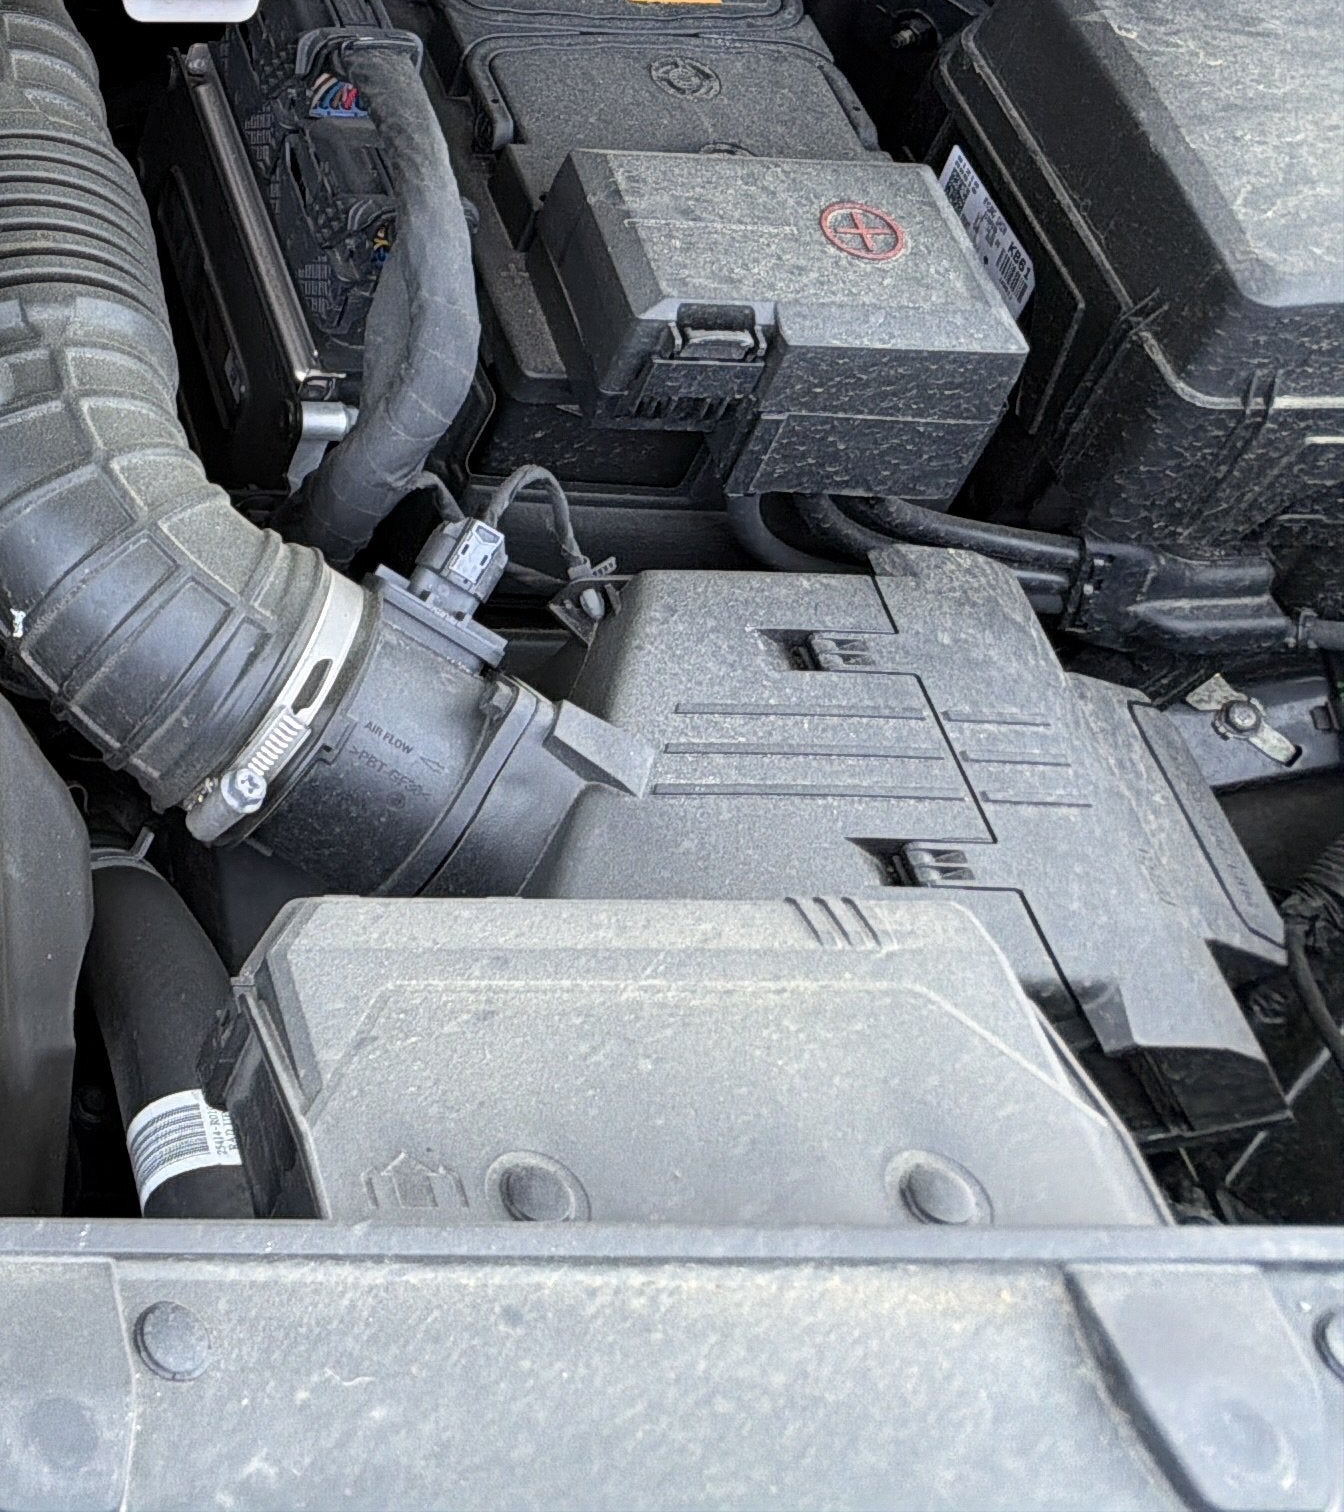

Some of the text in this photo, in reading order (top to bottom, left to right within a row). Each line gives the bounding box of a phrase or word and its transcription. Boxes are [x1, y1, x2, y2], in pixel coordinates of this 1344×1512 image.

[1006, 241, 1031, 281] KB61
[364, 720, 414, 754] AIR FLOW
